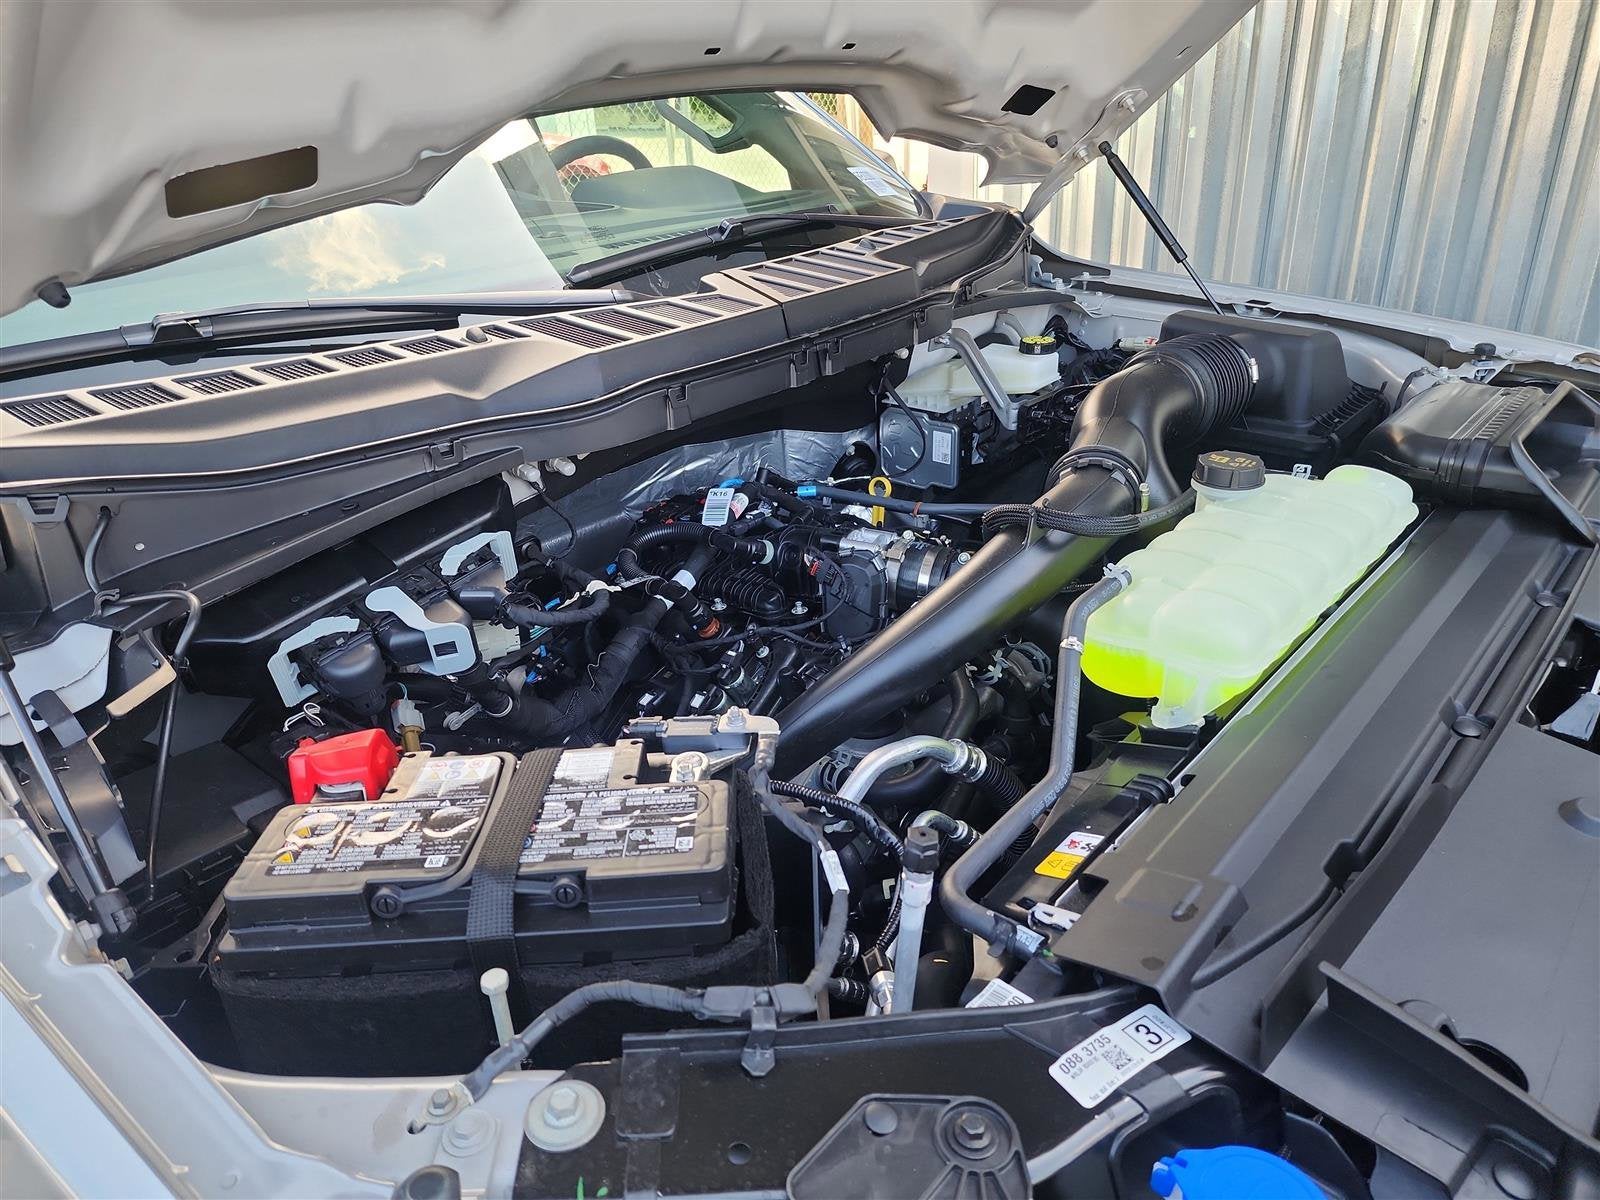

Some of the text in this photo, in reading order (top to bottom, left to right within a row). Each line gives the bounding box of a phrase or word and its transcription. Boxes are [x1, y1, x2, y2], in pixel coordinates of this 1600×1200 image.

[1134, 1023, 1163, 1045] 3
[1059, 1053, 1083, 1075] 088
[1081, 1034, 1111, 1058] 3735
